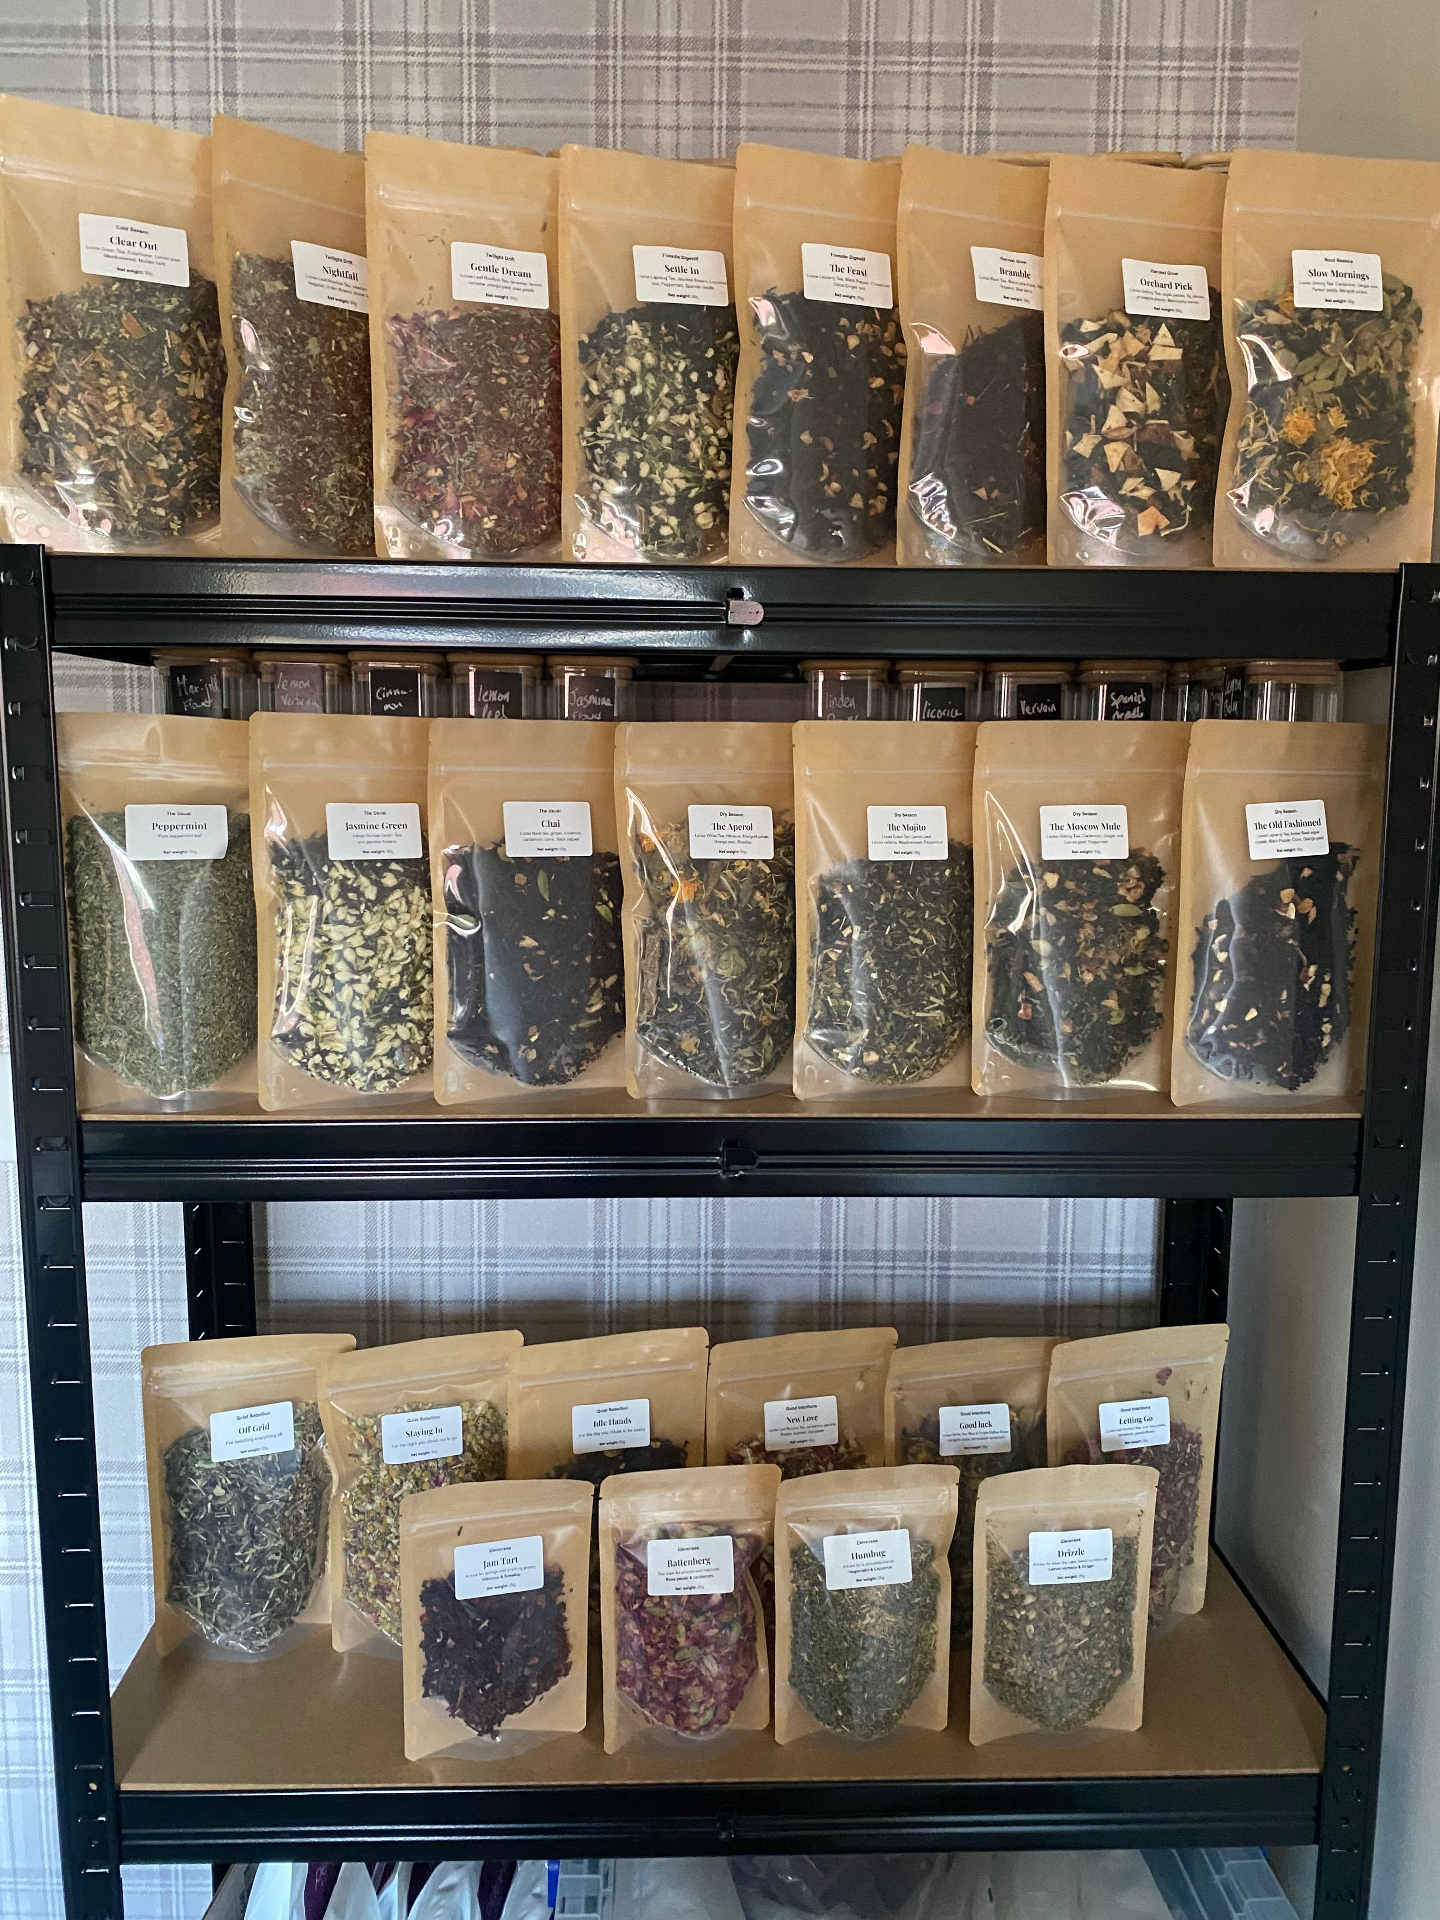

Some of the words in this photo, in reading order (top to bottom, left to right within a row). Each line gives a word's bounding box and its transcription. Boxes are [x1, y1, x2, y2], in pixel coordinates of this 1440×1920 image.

[109, 235, 137, 247] Clear
[138, 240, 157, 251] Out
[322, 265, 358, 281] Nightfall
[470, 261, 499, 273] Gentle
[501, 266, 531, 278] Dream
[664, 264, 687, 273] Settle
[690, 266, 699, 275] In
[829, 263, 844, 273] The
[847, 266, 867, 276] Feast
[999, 266, 1030, 278] Bramble
[1308, 268, 1328, 277] Slow
[1330, 269, 1369, 281] Mornings
[1140, 278, 1172, 289] Orchard
[1174, 282, 1193, 290] Pick
[277, 671, 310, 690] lemon
[478, 684, 510, 703] lemon
[569, 687, 613, 708] Jasmine
[825, 686, 856, 710] linden
[922, 700, 963, 720] licorice
[152, 821, 207, 831] Peppermint
[345, 821, 379, 831] Jasmine
[381, 821, 407, 829] Green
[541, 819, 560, 827] Chai
[711, 822, 726, 830] The
[727, 822, 753, 832] Aperol
[886, 823, 900, 831] The
[901, 823, 926, 832] Mojito
[1048, 822, 1064, 830] The
[1066, 822, 1099, 830] Moscow
[1101, 822, 1120, 830] Mule
[1253, 821, 1267, 830] The
[1268, 820, 1282, 829] Old
[1283, 818, 1321, 828] Fashioned
[593, 1419, 607, 1427] Idle
[608, 1417, 631, 1425] Hands
[802, 1414, 818, 1422] Love
[959, 1420, 976, 1429] Good
[977, 1419, 993, 1427] luck
[1119, 1416, 1142, 1425] Letting
[1143, 1414, 1153, 1422] Go
[238, 1425, 251, 1435] Off
[252, 1422, 270, 1432] Grid
[405, 1427, 433, 1439] Staying
[434, 1426, 442, 1434] In
[851, 1549, 886, 1560] Humbug
[1057, 1547, 1084, 1557] Drizzle
[483, 1559, 498, 1569] Jam
[500, 1555, 518, 1565] Tart
[667, 1556, 710, 1567] Battenberg
